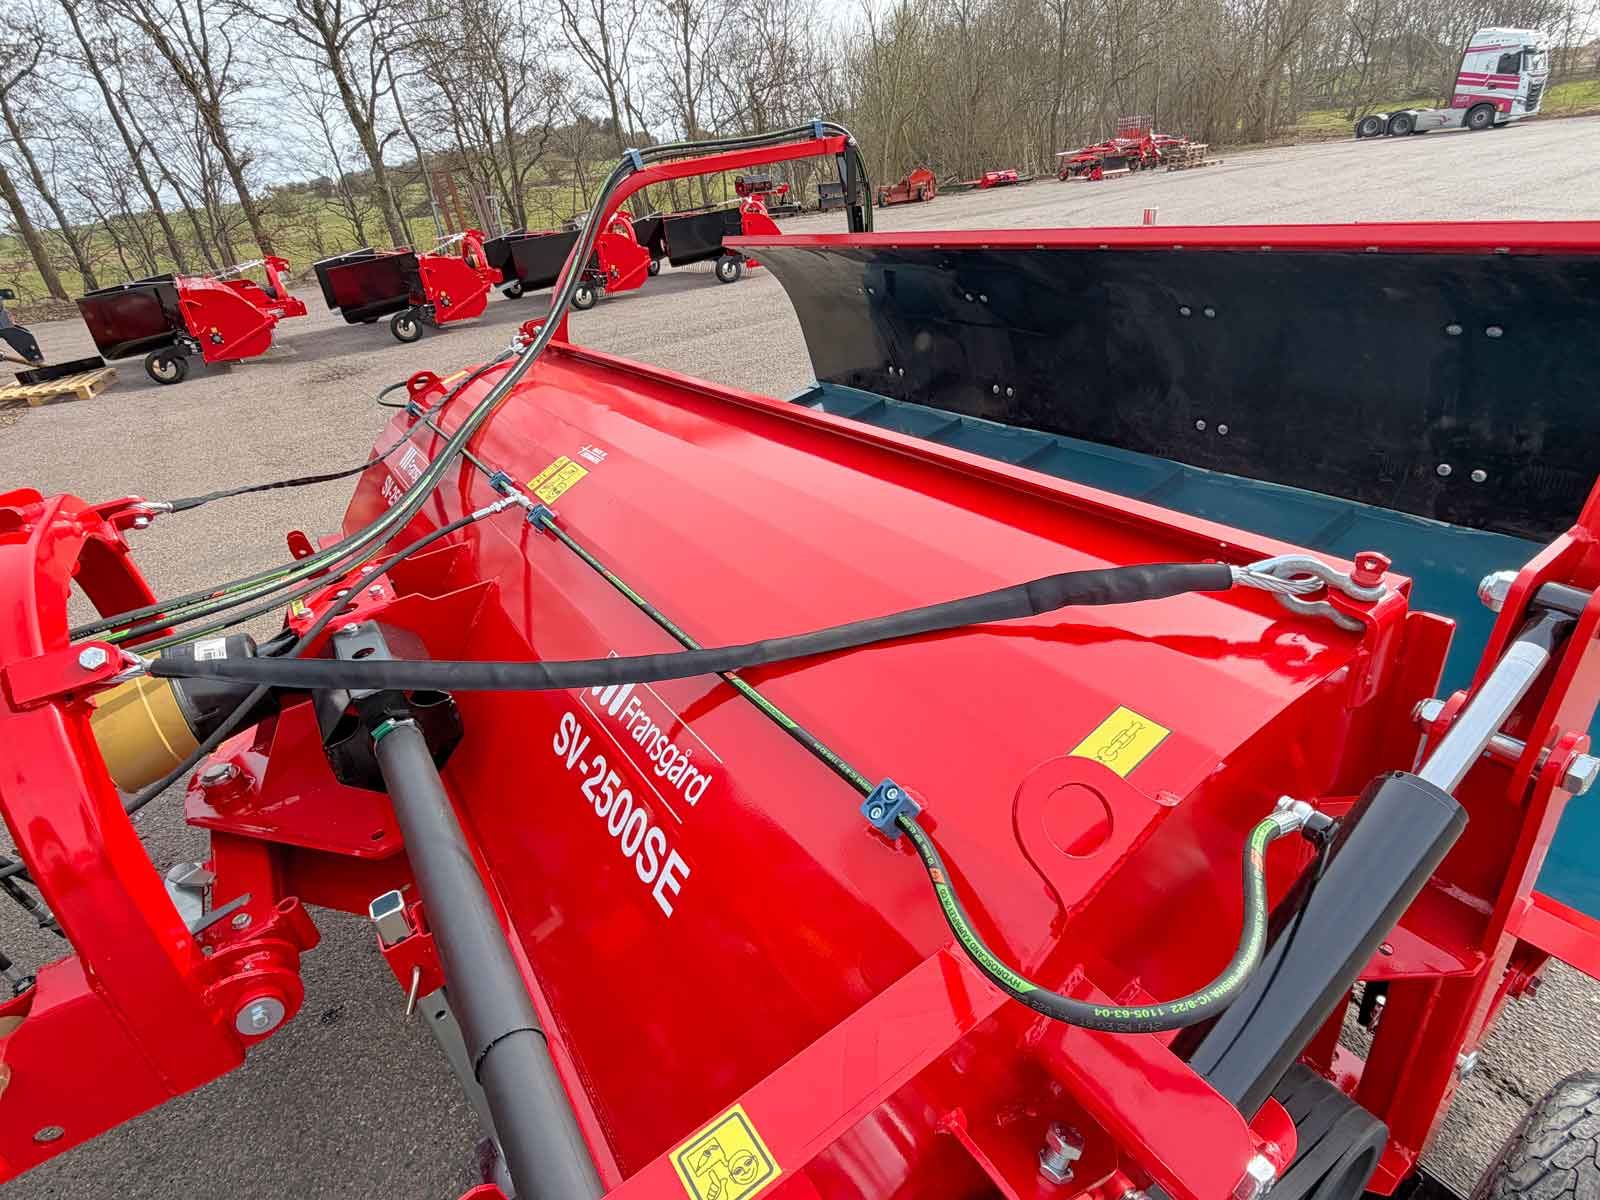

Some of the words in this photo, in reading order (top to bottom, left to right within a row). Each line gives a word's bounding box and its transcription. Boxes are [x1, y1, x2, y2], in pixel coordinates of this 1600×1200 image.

[618, 696, 712, 806] Fransgård
[553, 711, 691, 918] SV-2500SE
[968, 941, 1021, 989] HYDROSCAND
[1095, 1006, 1163, 1018] 1105-63-04
